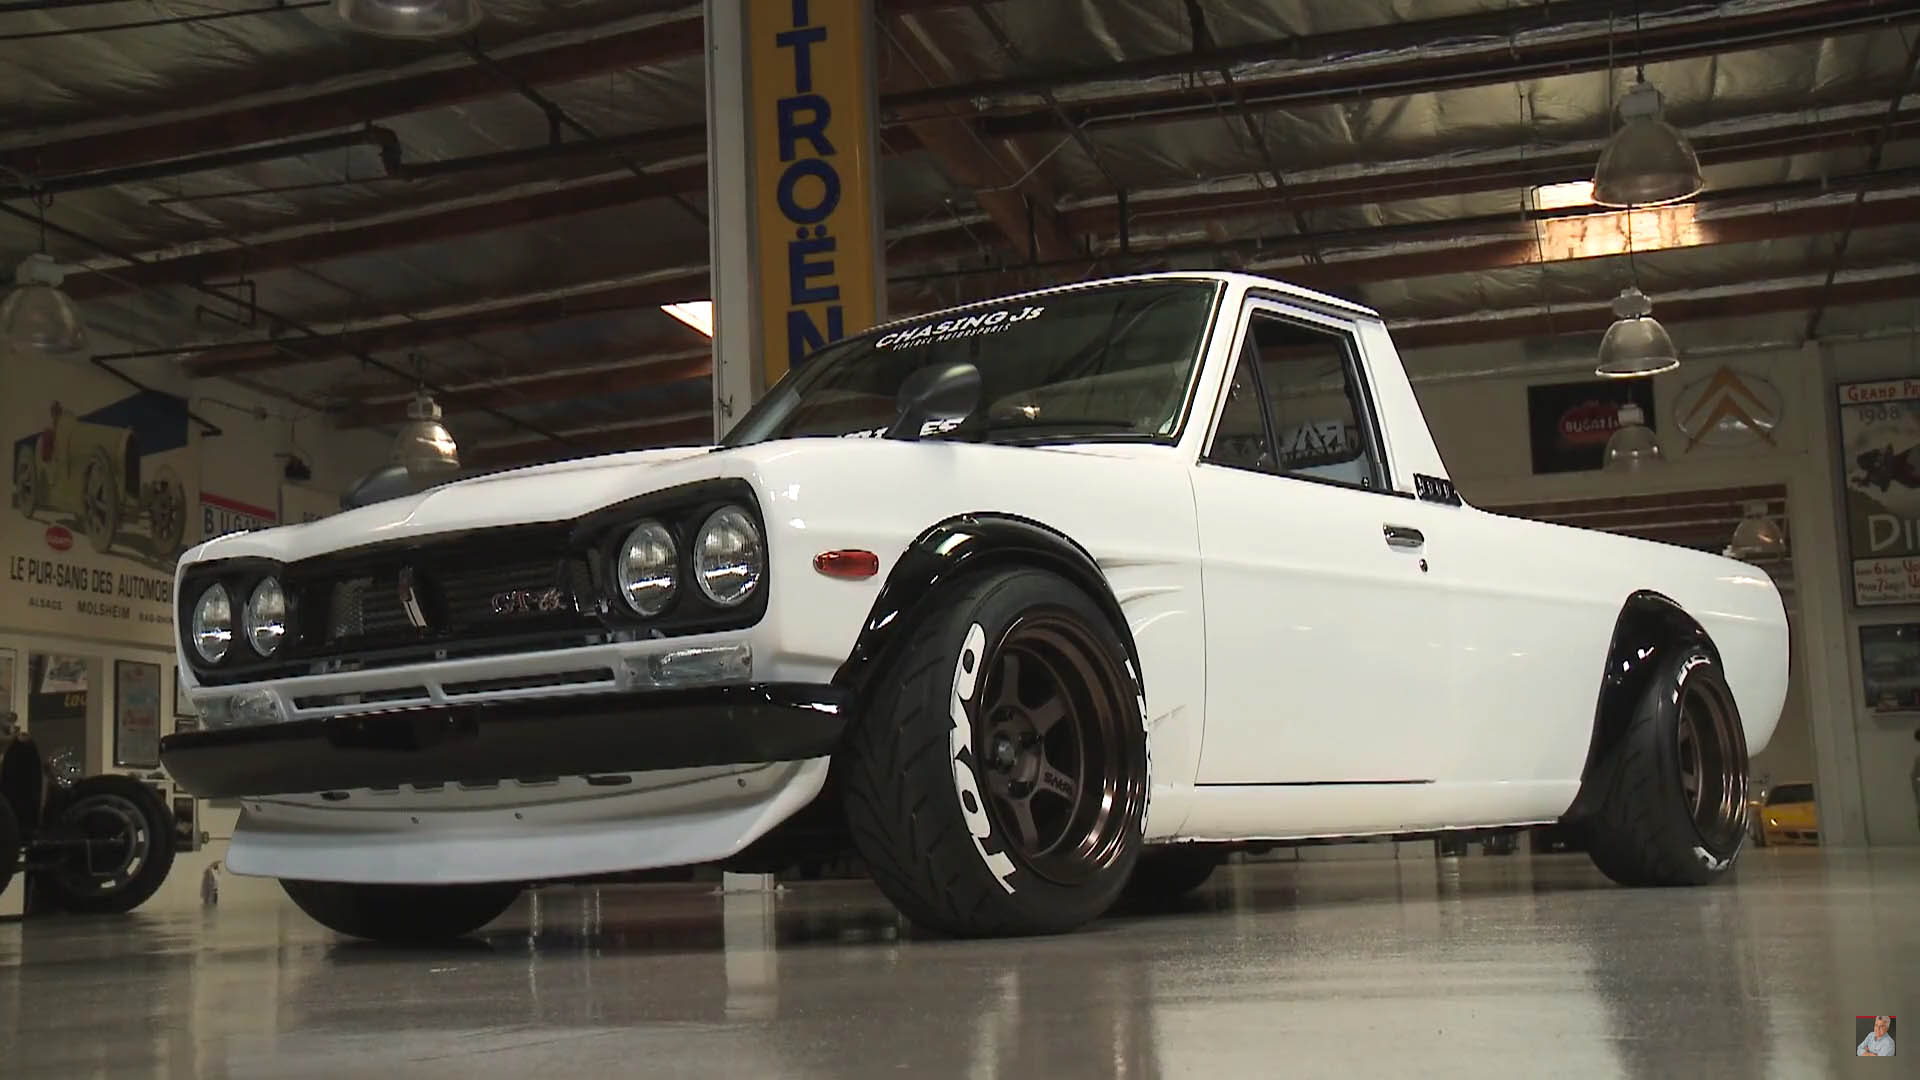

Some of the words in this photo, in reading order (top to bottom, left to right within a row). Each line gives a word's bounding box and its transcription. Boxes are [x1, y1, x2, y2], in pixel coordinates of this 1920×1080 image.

[875, 311, 1008, 348] CHASING
[1847, 382, 1896, 401] GRAND
[10, 555, 25, 581] LE
[28, 559, 88, 591] PUR-SANG
[92, 569, 113, 594] DES
[77, 599, 130, 619] MOLSHEIM
